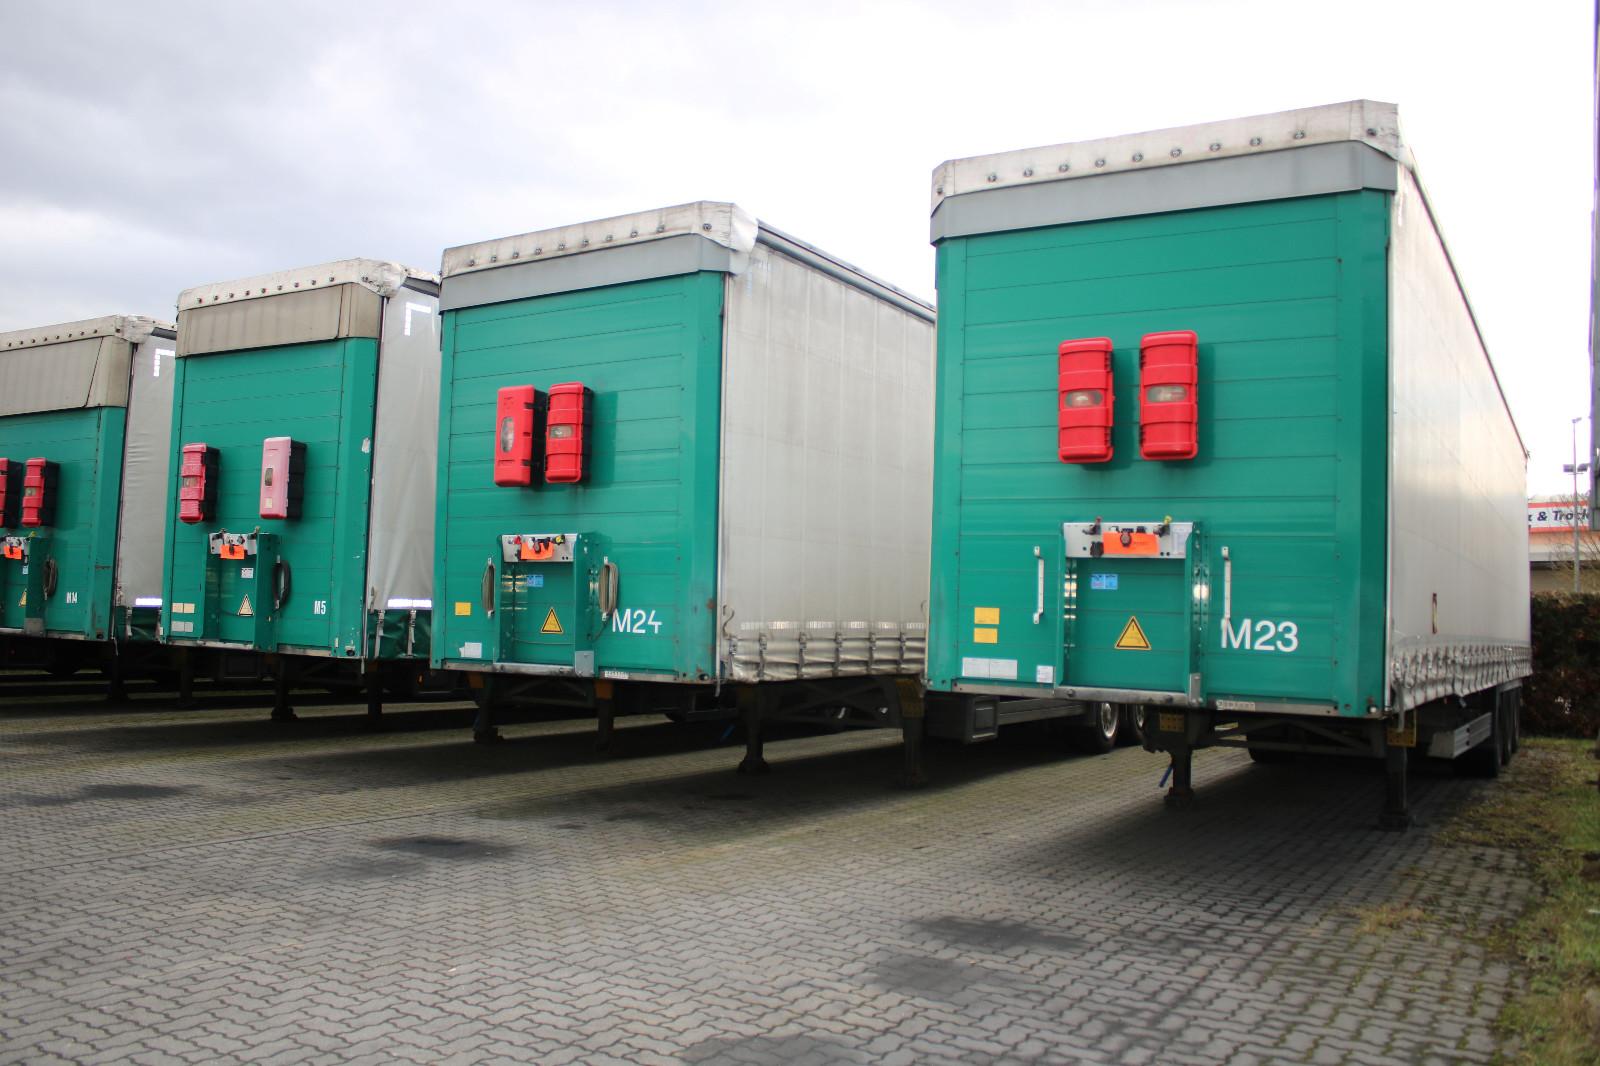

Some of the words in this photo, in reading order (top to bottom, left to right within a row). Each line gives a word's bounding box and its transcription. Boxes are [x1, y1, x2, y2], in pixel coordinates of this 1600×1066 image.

[1537, 511, 1548, 521] &
[314, 600, 327, 615] M5
[612, 608, 662, 634] M24
[1220, 618, 1298, 652] M23
